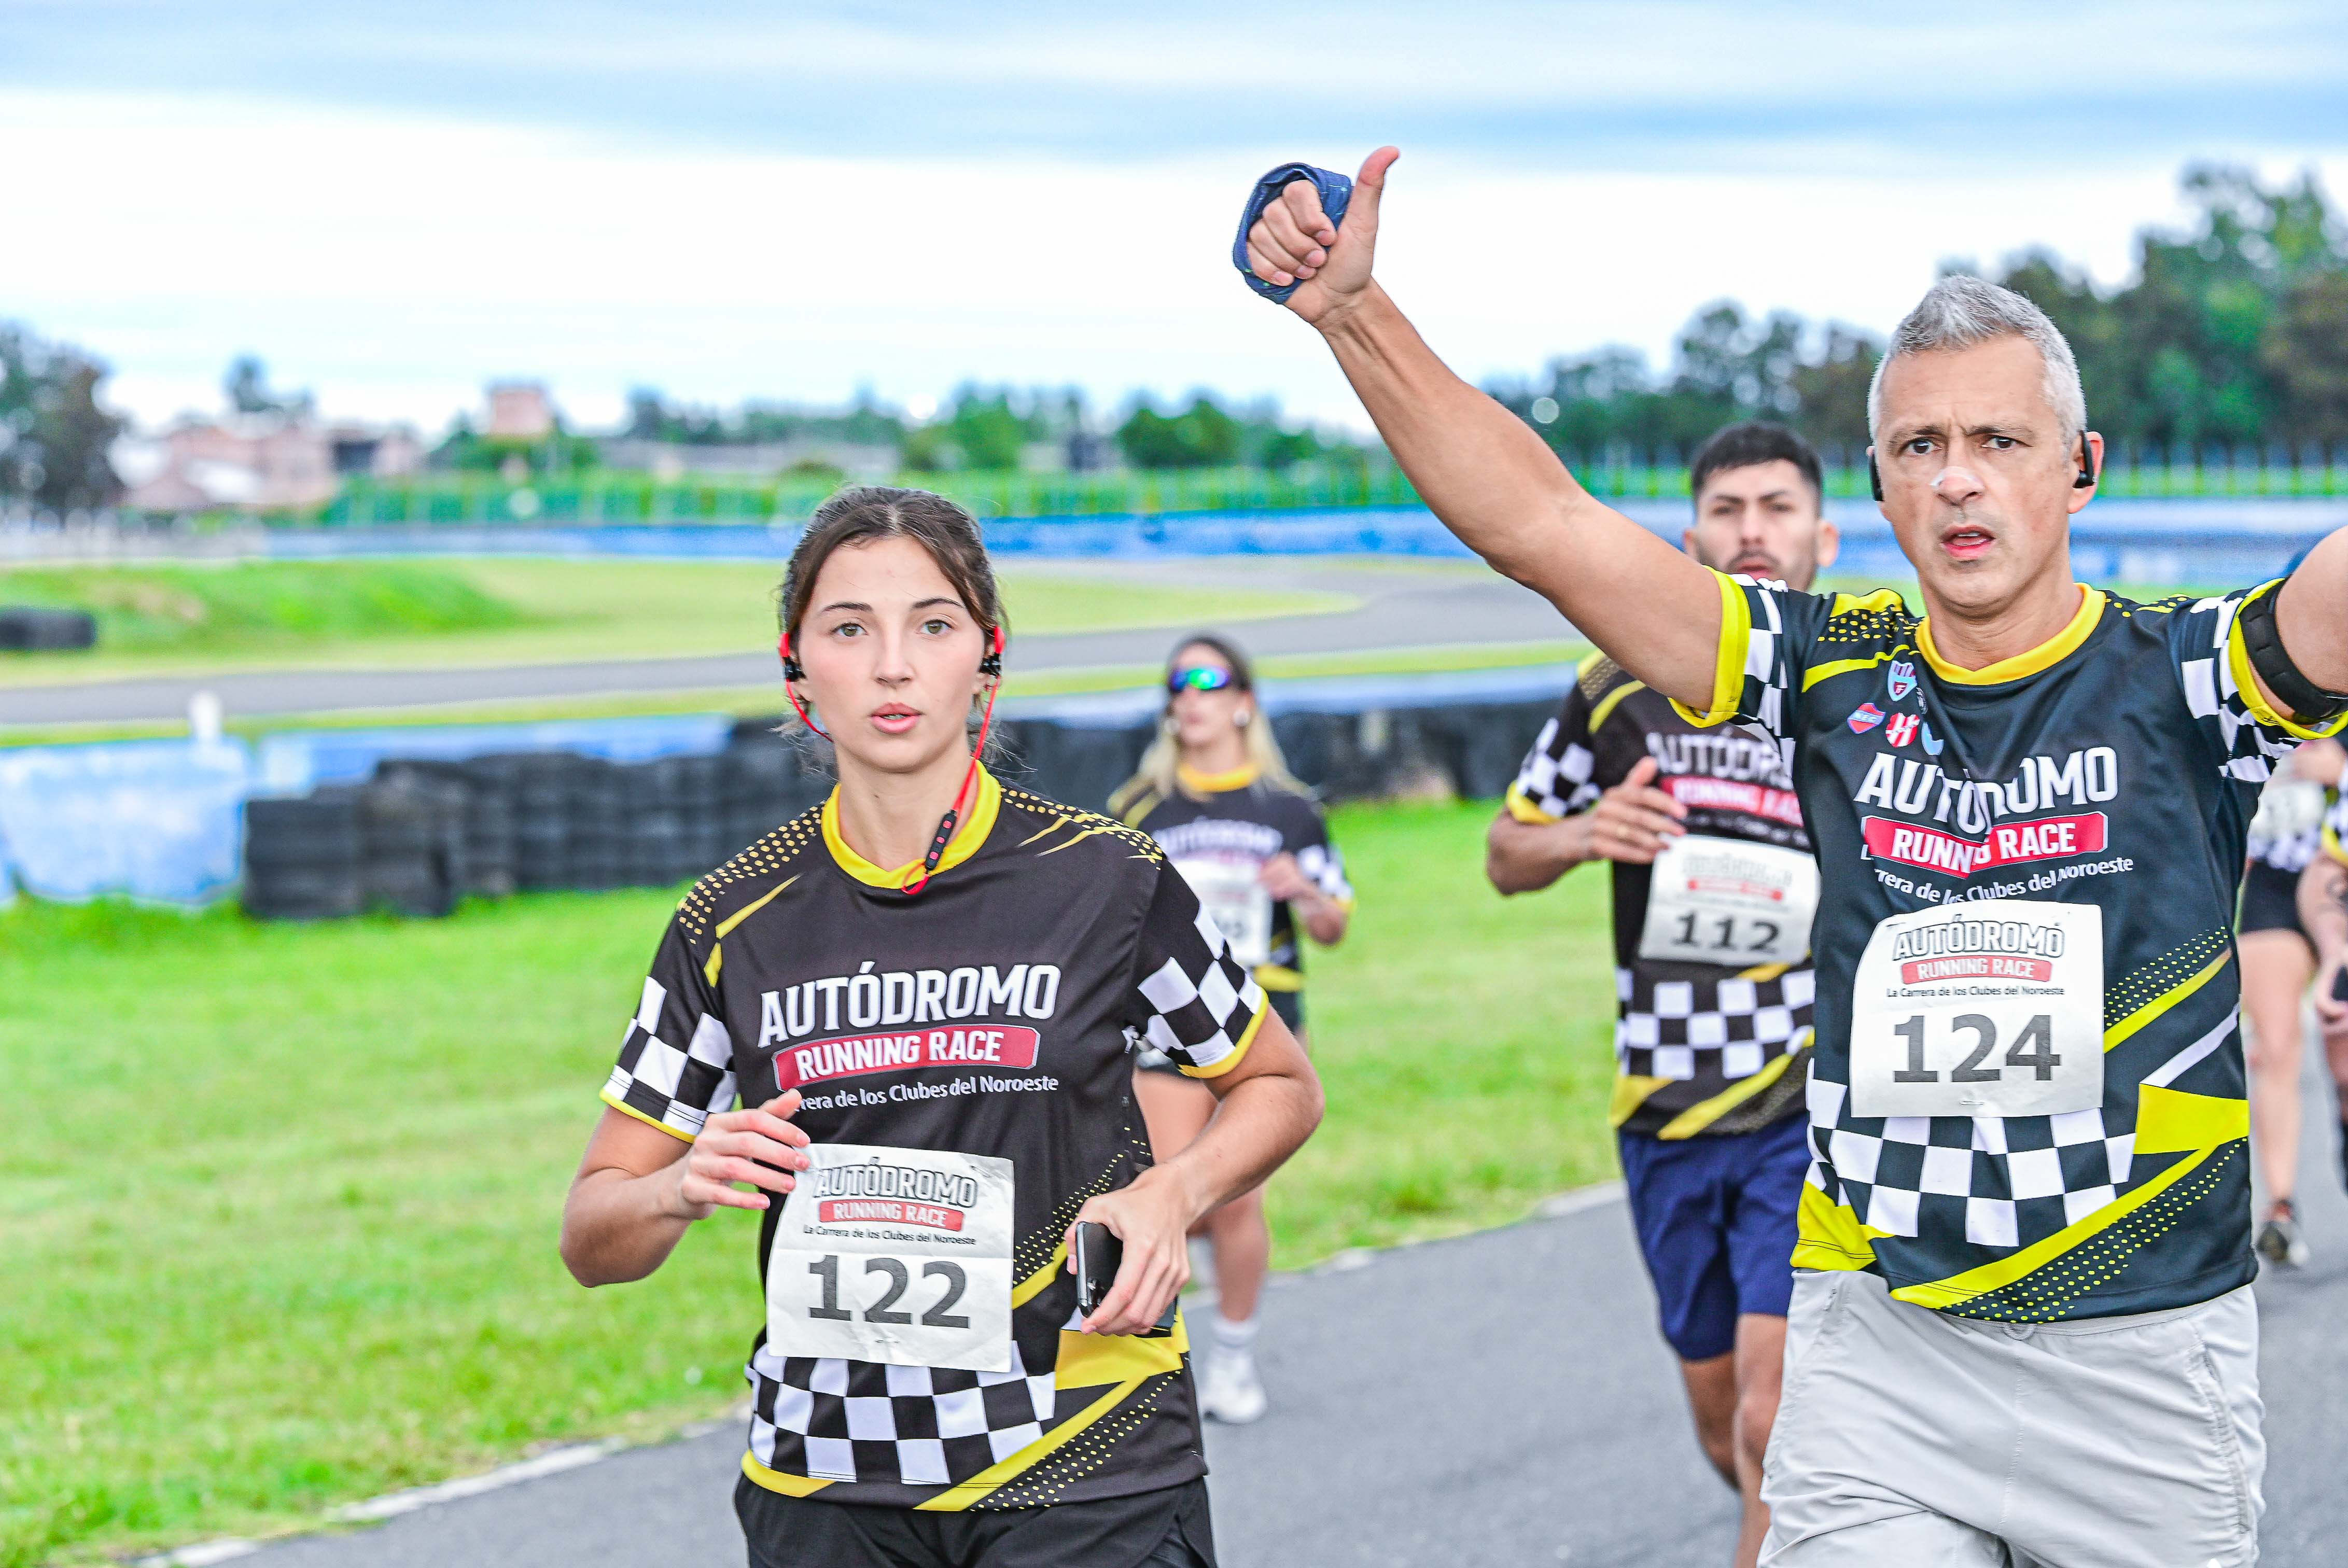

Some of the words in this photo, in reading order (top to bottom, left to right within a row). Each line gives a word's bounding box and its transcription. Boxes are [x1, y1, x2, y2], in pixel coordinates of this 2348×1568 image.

[1997, 822, 2076, 859] RACE
[1916, 883, 1941, 902] de
[1967, 882, 2026, 901] Clubes
[2028, 871, 2057, 891] del
[1670, 910, 1782, 954] 112
[1892, 914, 2065, 961] AUTÓDROMO
[1916, 958, 1989, 979] RUNNING
[1992, 959, 2037, 978] RACE
[758, 961, 1061, 1048] AUTÓDROMO
[1886, 988, 1898, 997] La
[1900, 987, 1936, 997] Carrera
[1939, 987, 1950, 996] de
[1952, 987, 1966, 996] los
[1970, 986, 2002, 996] Clubes
[2005, 986, 2019, 995] del
[2022, 986, 2065, 995] Noroeste
[794, 1034, 921, 1081] RUNNING
[929, 1030, 1004, 1062] RACE
[1893, 1013, 2061, 1083] 124
[835, 1090, 858, 1108] de
[859, 1088, 887, 1105] los
[889, 1081, 948, 1102] Clubes
[949, 1076, 976, 1096] del
[980, 1075, 1059, 1093] Noroeste
[813, 1156, 978, 1208] AUTÓDROMO
[832, 1202, 903, 1220] RUNNING
[905, 1204, 948, 1227] RACE
[803, 1225, 814, 1234] La
[816, 1226, 849, 1237] Carrera
[852, 1228, 863, 1238] de
[866, 1228, 880, 1239] los
[882, 1230, 915, 1241] Clubes
[916, 1232, 931, 1242] del
[933, 1234, 977, 1245] Noroeste
[808, 1254, 971, 1329] 122
